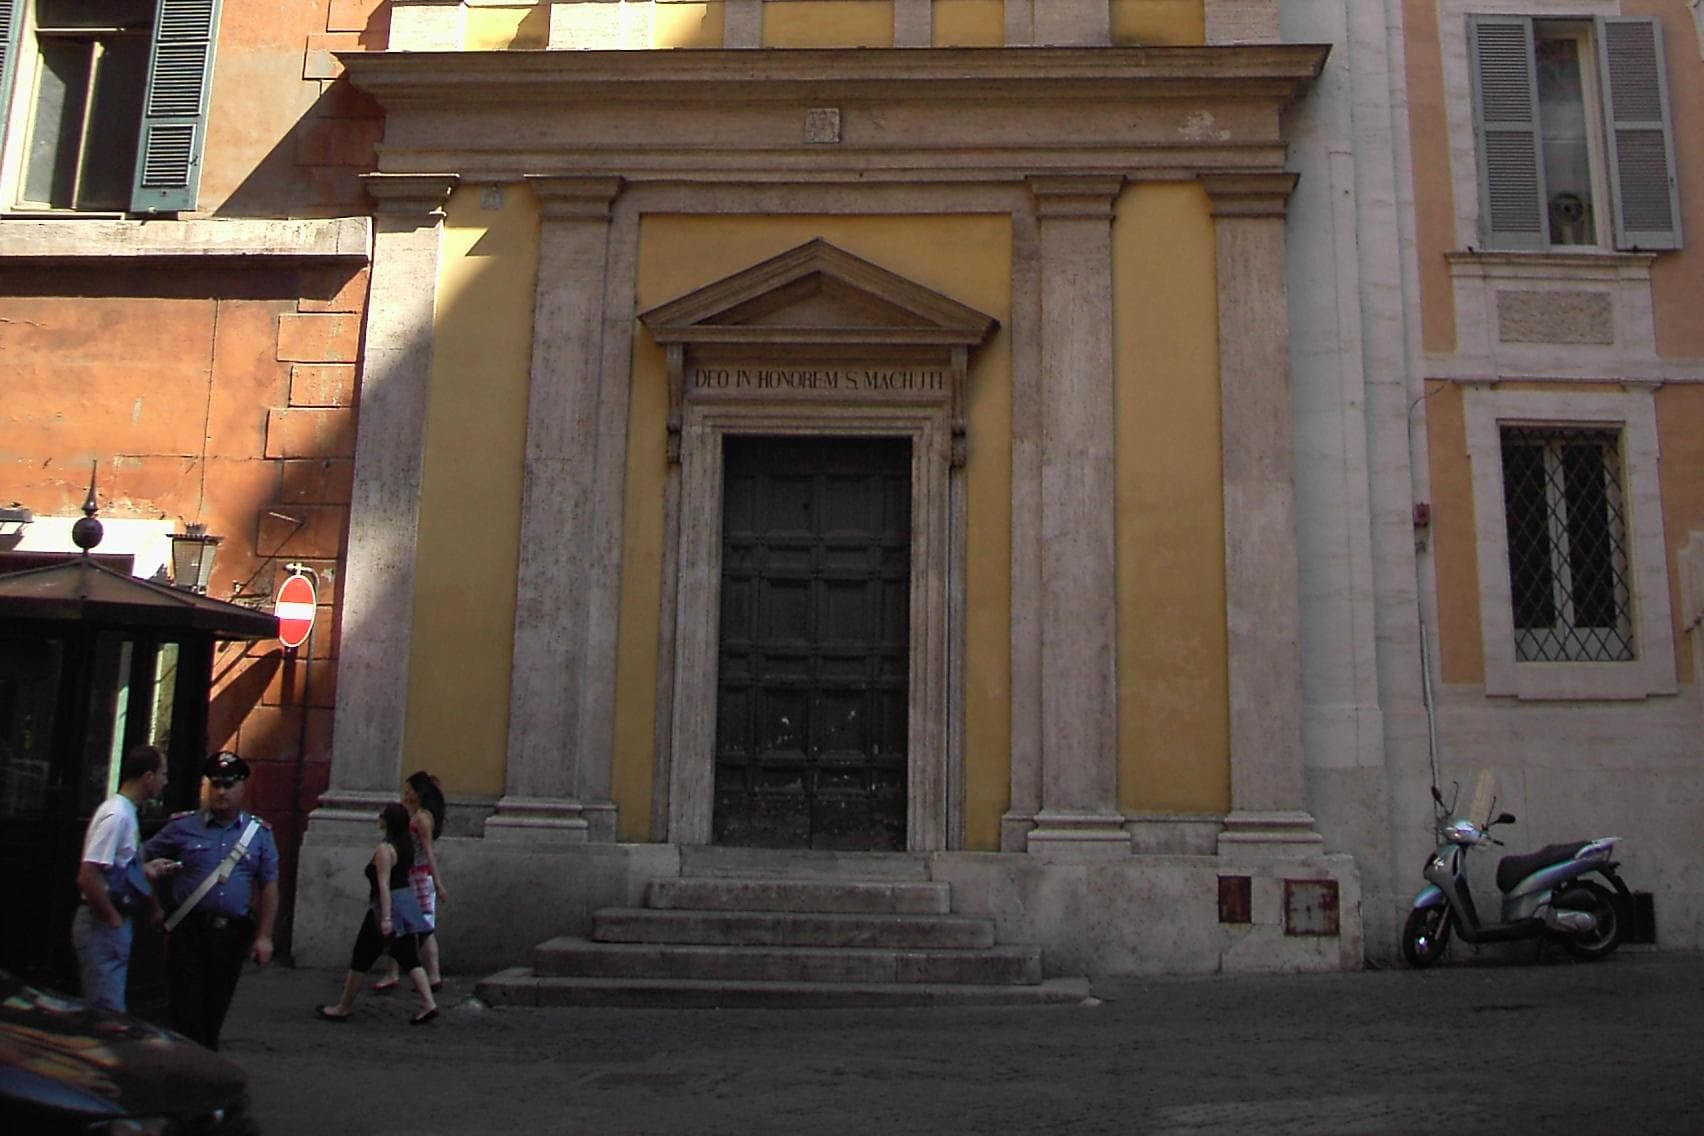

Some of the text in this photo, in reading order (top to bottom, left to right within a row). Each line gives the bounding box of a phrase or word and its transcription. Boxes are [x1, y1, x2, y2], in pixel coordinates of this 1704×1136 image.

[695, 369, 729, 389] DEO
[736, 369, 751, 388] IN
[757, 369, 838, 389] HONOREM
[864, 371, 943, 390] MACHUTI
